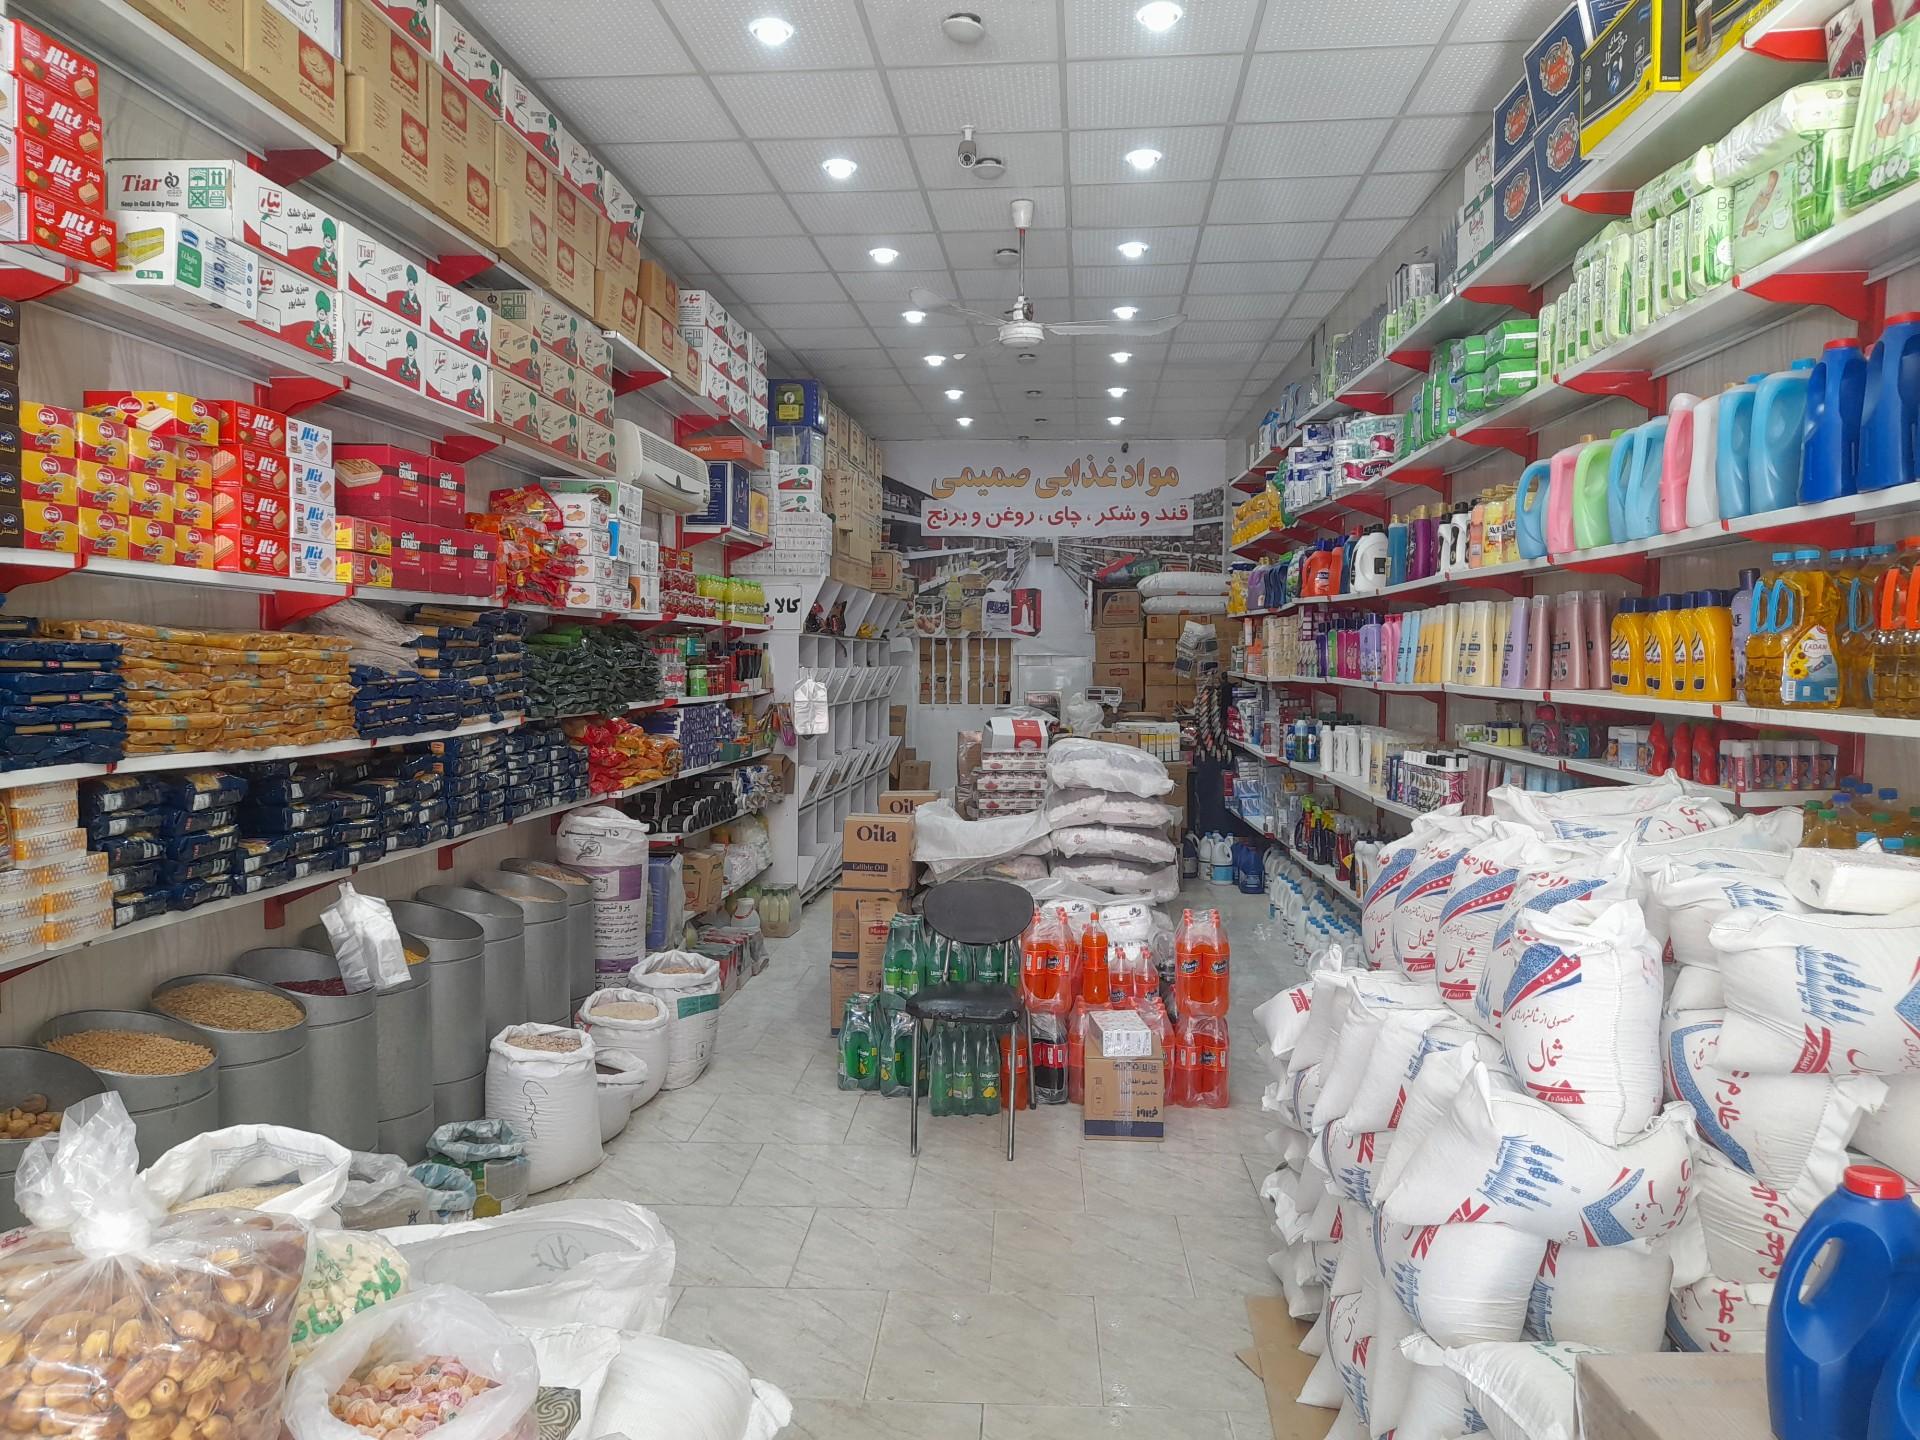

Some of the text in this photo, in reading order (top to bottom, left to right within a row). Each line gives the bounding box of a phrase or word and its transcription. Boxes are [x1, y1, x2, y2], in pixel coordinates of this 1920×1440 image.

[42, 45, 78, 75] Hit
[46, 101, 82, 129] Hit
[46, 155, 82, 181] Hit
[121, 174, 162, 192] Tiar
[121, 201, 134, 209] Keep
[156, 201, 165, 209] Dry
[58, 210, 94, 236] Hit
[358, 244, 374, 258] Tiar
[252, 413, 275, 431] Hit
[300, 426, 320, 443] Hit
[256, 456, 278, 473] Hit
[304, 467, 324, 483] Hit
[398, 468, 418, 481] ERNEST
[931, 454, 1180, 499] مواد غذایی صمیمی
[440, 478, 458, 490] ERNEST
[256, 497, 278, 514] Hit
[306, 506, 324, 521] Hit
[1154, 505, 1189, 523] قند
[926, 506, 968, 530] برنج
[971, 512, 982, 528] و
[986, 506, 1036, 528] روغن
[1138, 511, 1150, 528] و
[256, 539, 279, 555] Hit
[304, 545, 324, 560] Hit
[400, 538, 420, 550] ERNEST
[440, 545, 458, 556] ERNEST
[774, 598, 800, 614] کالا
[856, 824, 897, 842] Oila
[1444, 947, 1476, 973] شمال
[1527, 1037, 1564, 1073] شمال
[1136, 1106, 1158, 1118] فیروز
